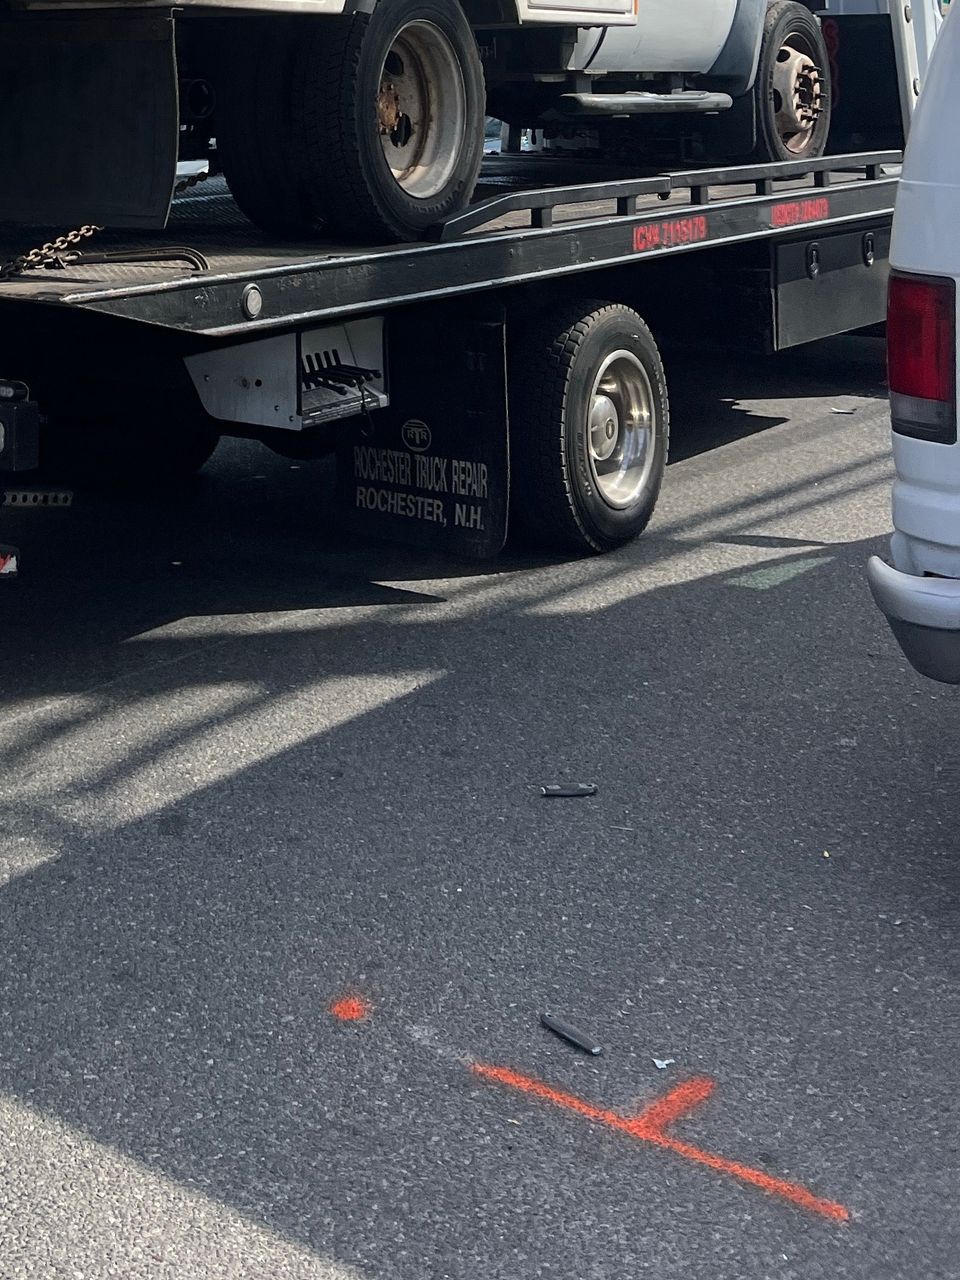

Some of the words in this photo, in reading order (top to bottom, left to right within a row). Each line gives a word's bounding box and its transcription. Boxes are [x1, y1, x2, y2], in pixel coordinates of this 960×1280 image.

[353, 445, 412, 486] ROCHESTER
[414, 454, 448, 493] TRUCK
[452, 459, 488, 499] REPAIR
[356, 486, 447, 527] ROCHESTER,
[454, 503, 485, 530] N.H.
